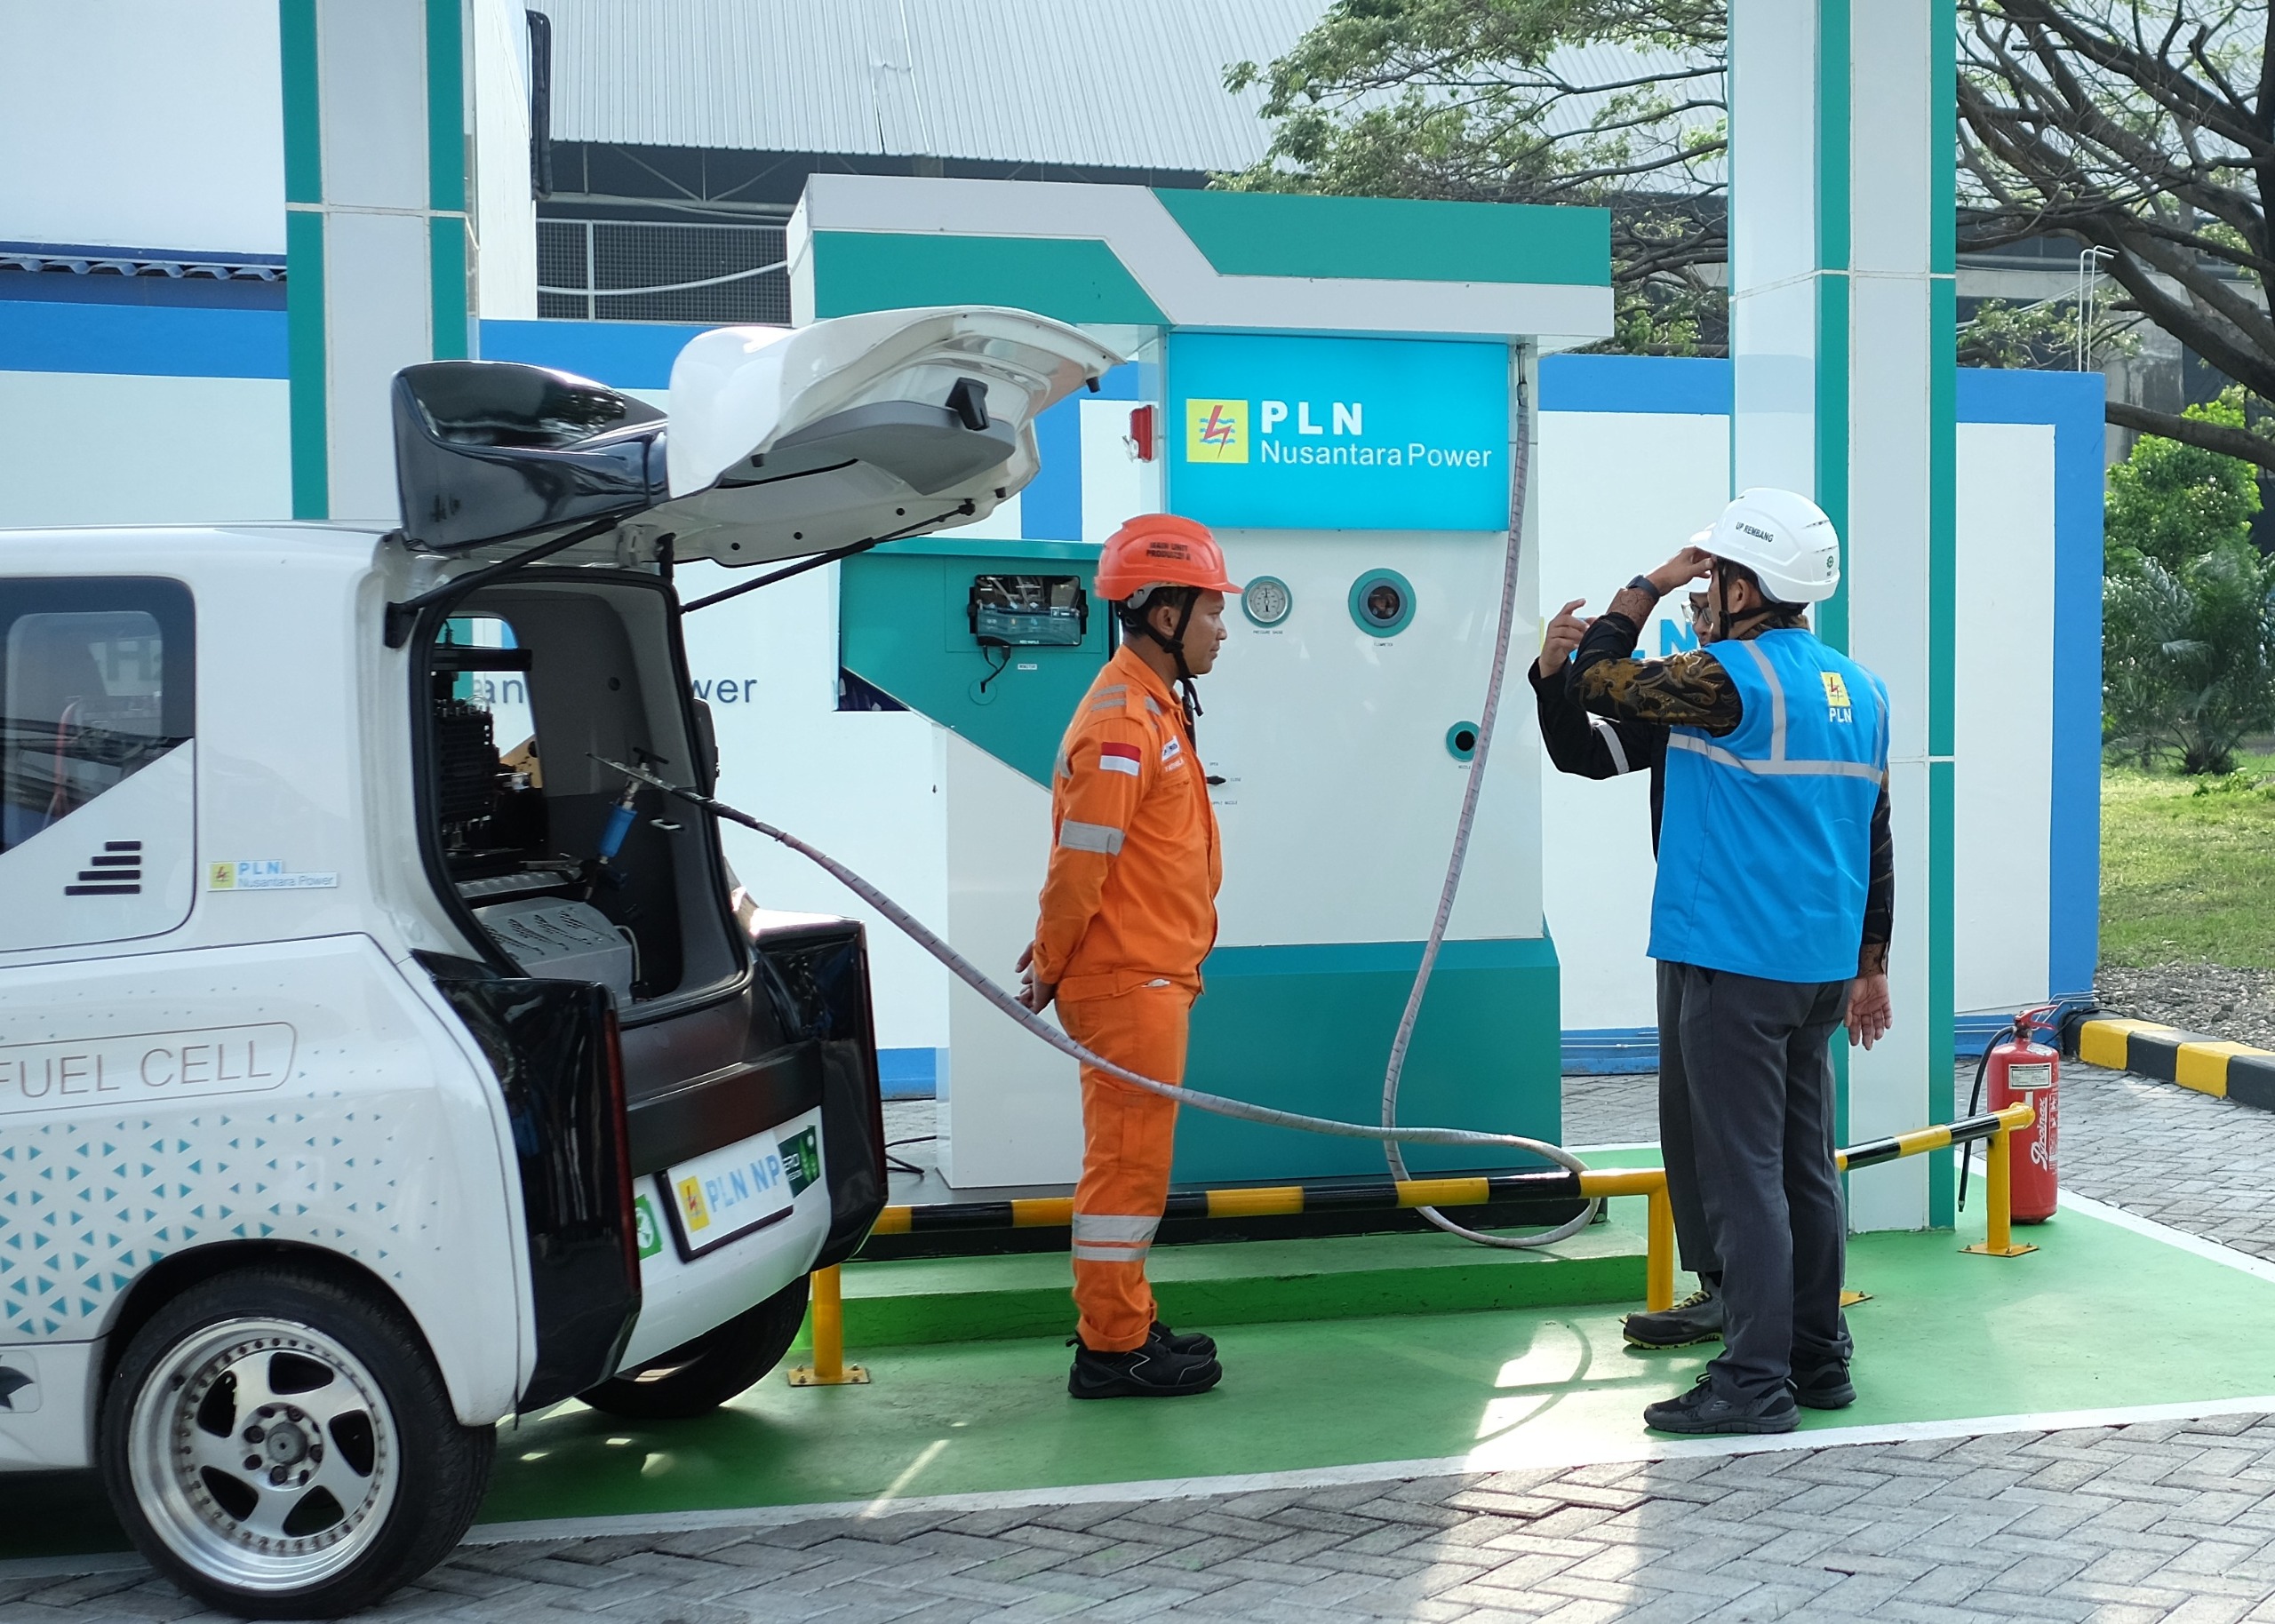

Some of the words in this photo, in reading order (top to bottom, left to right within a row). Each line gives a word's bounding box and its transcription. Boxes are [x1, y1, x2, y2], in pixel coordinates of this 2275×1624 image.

[1261, 400, 1362, 436] PLN
[1261, 440, 1402, 466] Nusantara
[1408, 442, 1492, 468] Power
[1736, 521, 1744, 531] UP
[1744, 524, 1774, 543] REMBANG
[693, 679, 757, 704] wer
[1829, 707, 1853, 723] PLN
[238, 861, 281, 876] PLN
[238, 875, 296, 888] Nusantara
[299, 874, 334, 888] Power
[140, 1039, 272, 1087] CELL
[705, 1168, 749, 1213] PLN
[749, 1154, 781, 1193] NP
